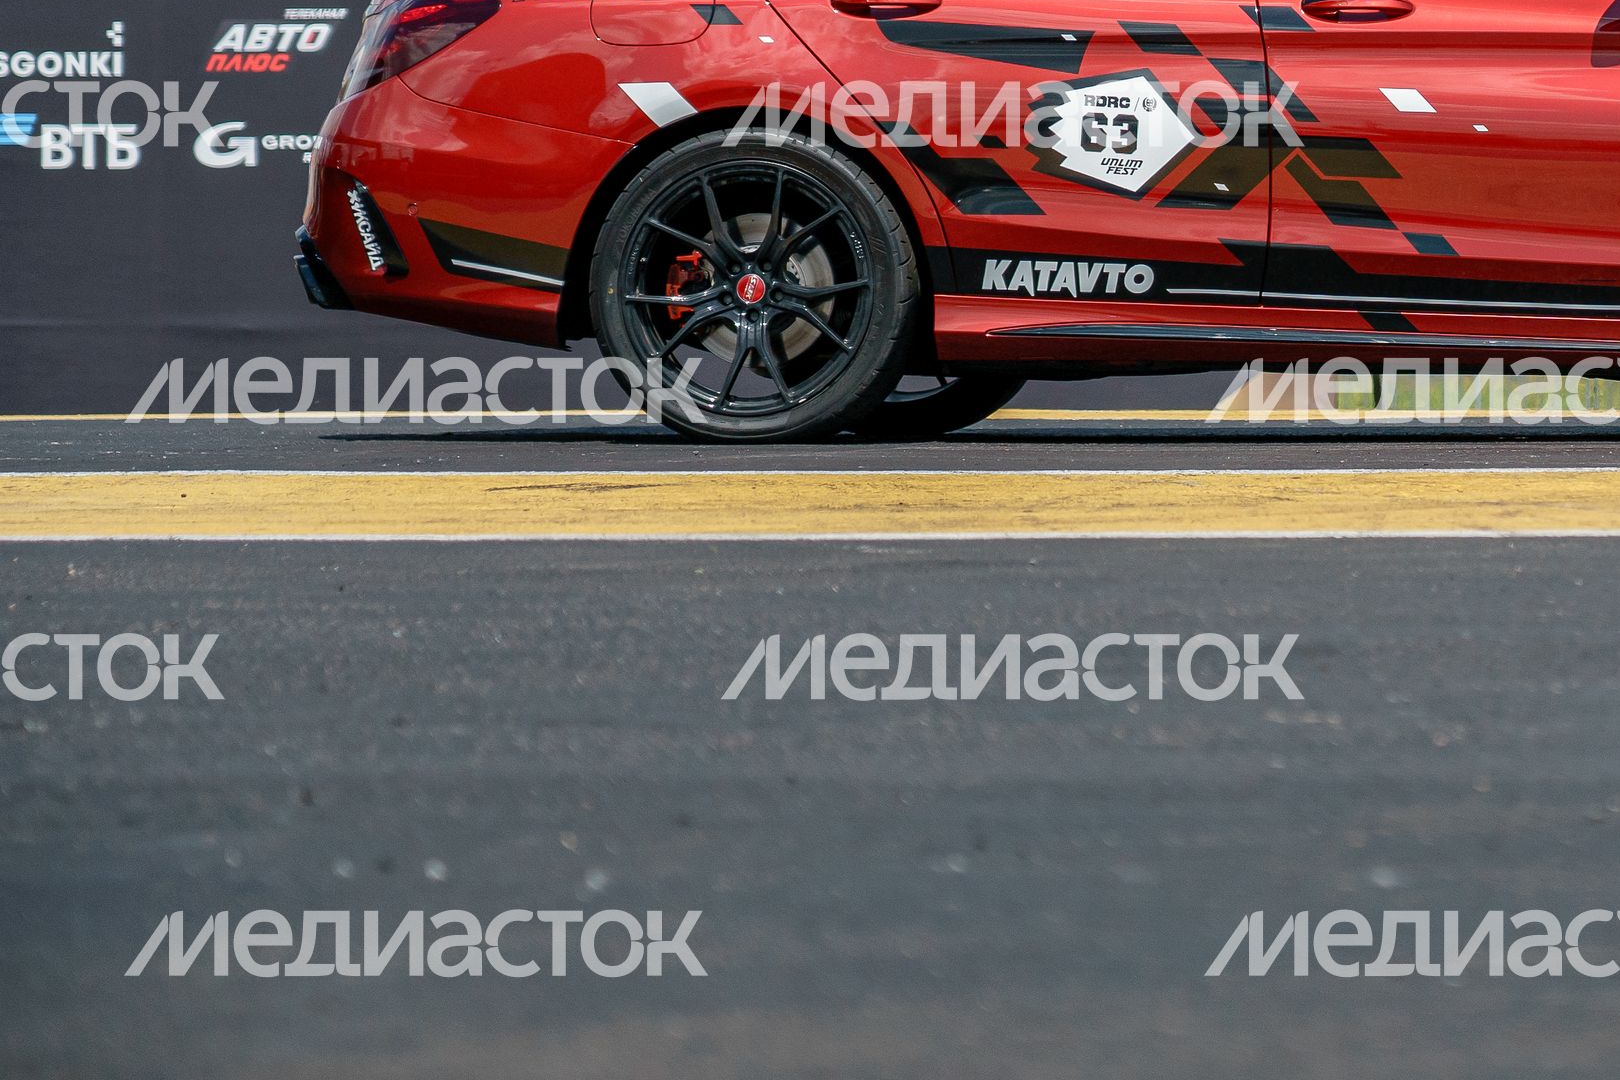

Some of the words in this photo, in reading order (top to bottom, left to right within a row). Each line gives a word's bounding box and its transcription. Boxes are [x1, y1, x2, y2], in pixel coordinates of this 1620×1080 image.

[213, 23, 332, 52] АВТО
[205, 54, 291, 72] ПЛЮС
[1084, 95, 1130, 108] RDRC
[1081, 112, 1139, 154] 63
[40, 123, 141, 170] ВТБ
[1101, 158, 1143, 168] UNLIM
[1106, 167, 1138, 176] FEST
[981, 259, 1155, 298] KATAVTO
